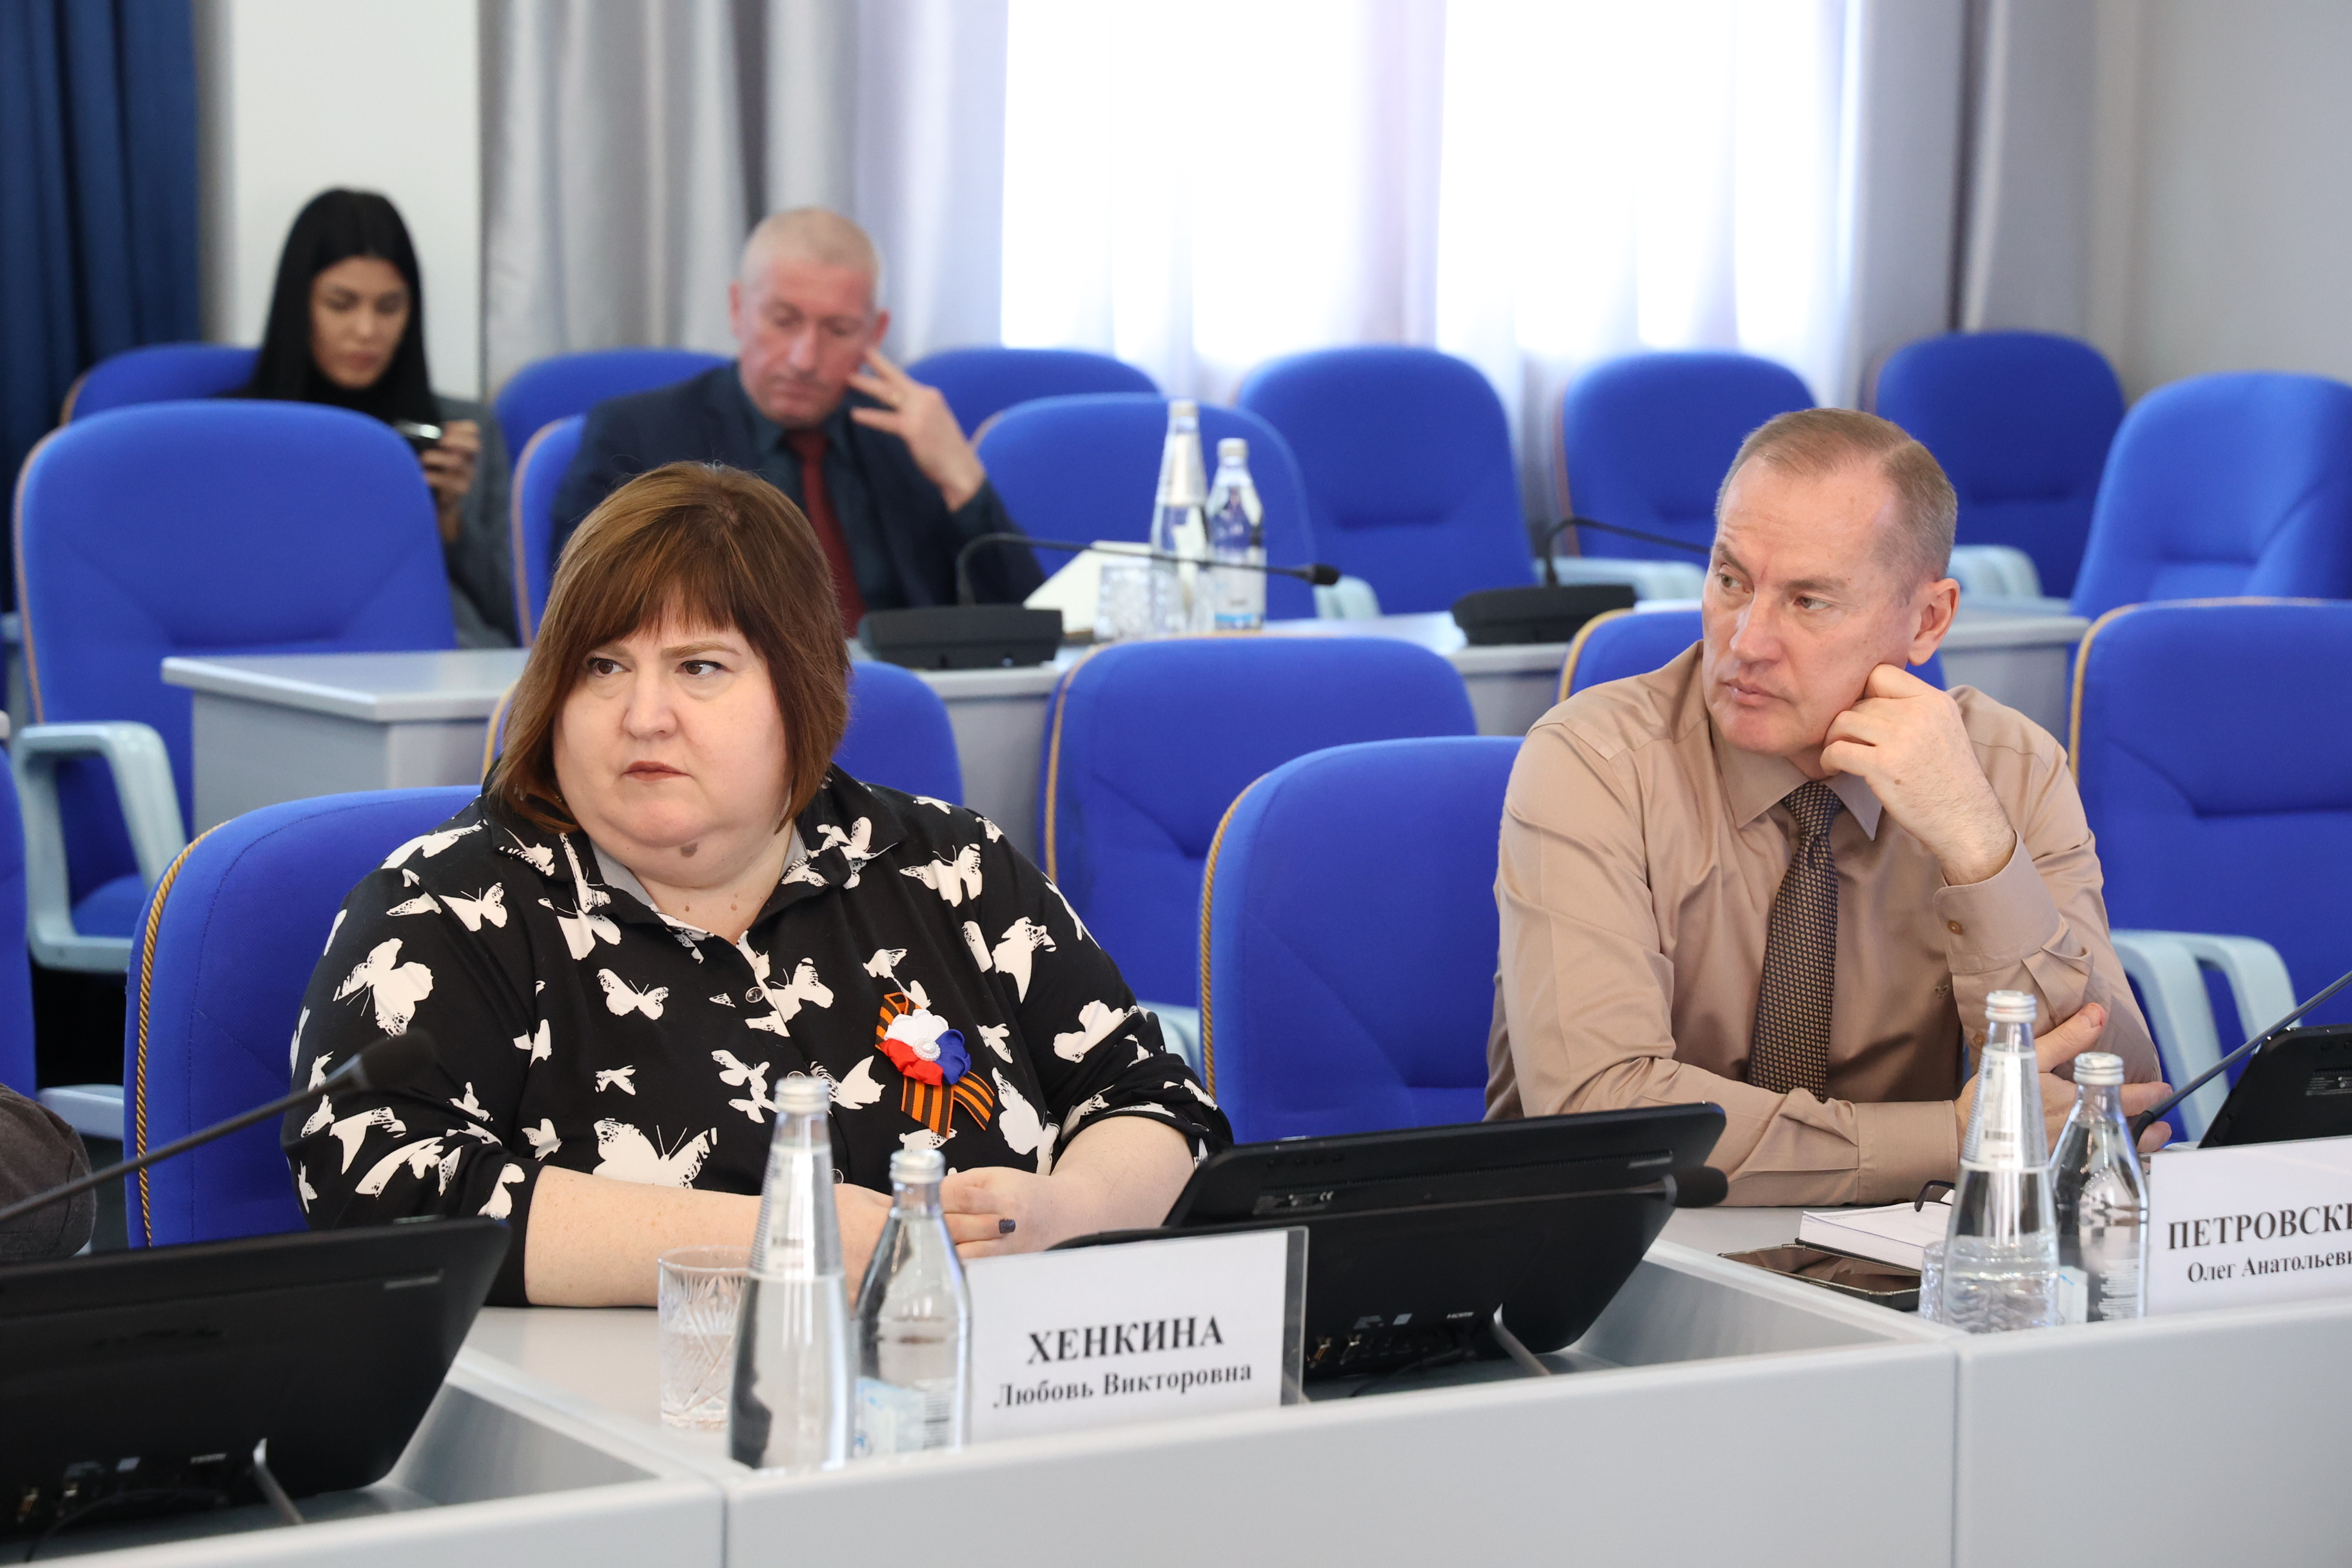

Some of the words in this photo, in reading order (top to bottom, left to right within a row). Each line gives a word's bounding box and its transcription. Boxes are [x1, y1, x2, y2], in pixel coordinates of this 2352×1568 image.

[2188, 1262, 2235, 1282] Олег
[1028, 1315, 1224, 1364] ХЕНКИНА
[993, 1379, 1094, 1407] Любовь
[1103, 1364, 1251, 1396] Викторовна
